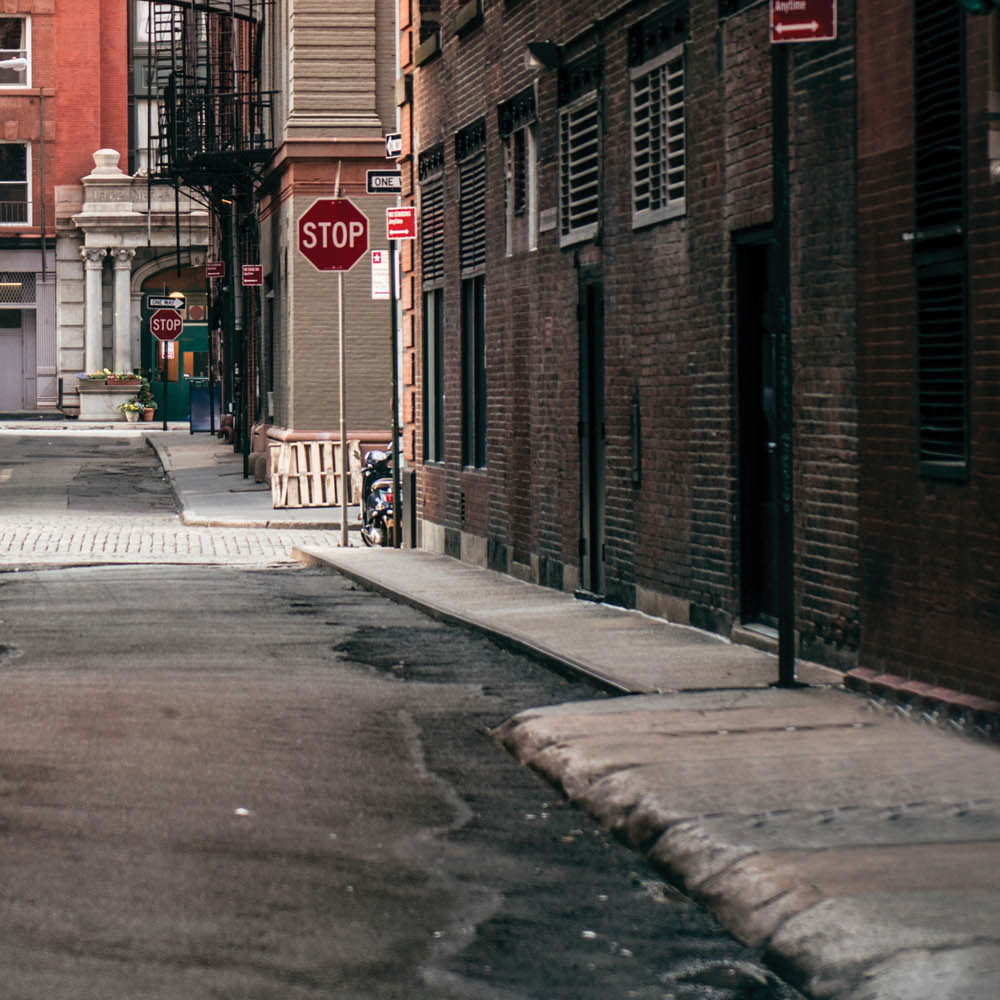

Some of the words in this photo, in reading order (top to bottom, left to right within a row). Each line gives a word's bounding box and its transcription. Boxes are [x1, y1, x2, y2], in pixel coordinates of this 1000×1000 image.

[374, 177, 394, 187] ONE
[303, 221, 364, 249] STOP
[152, 318, 181, 331] STOP
